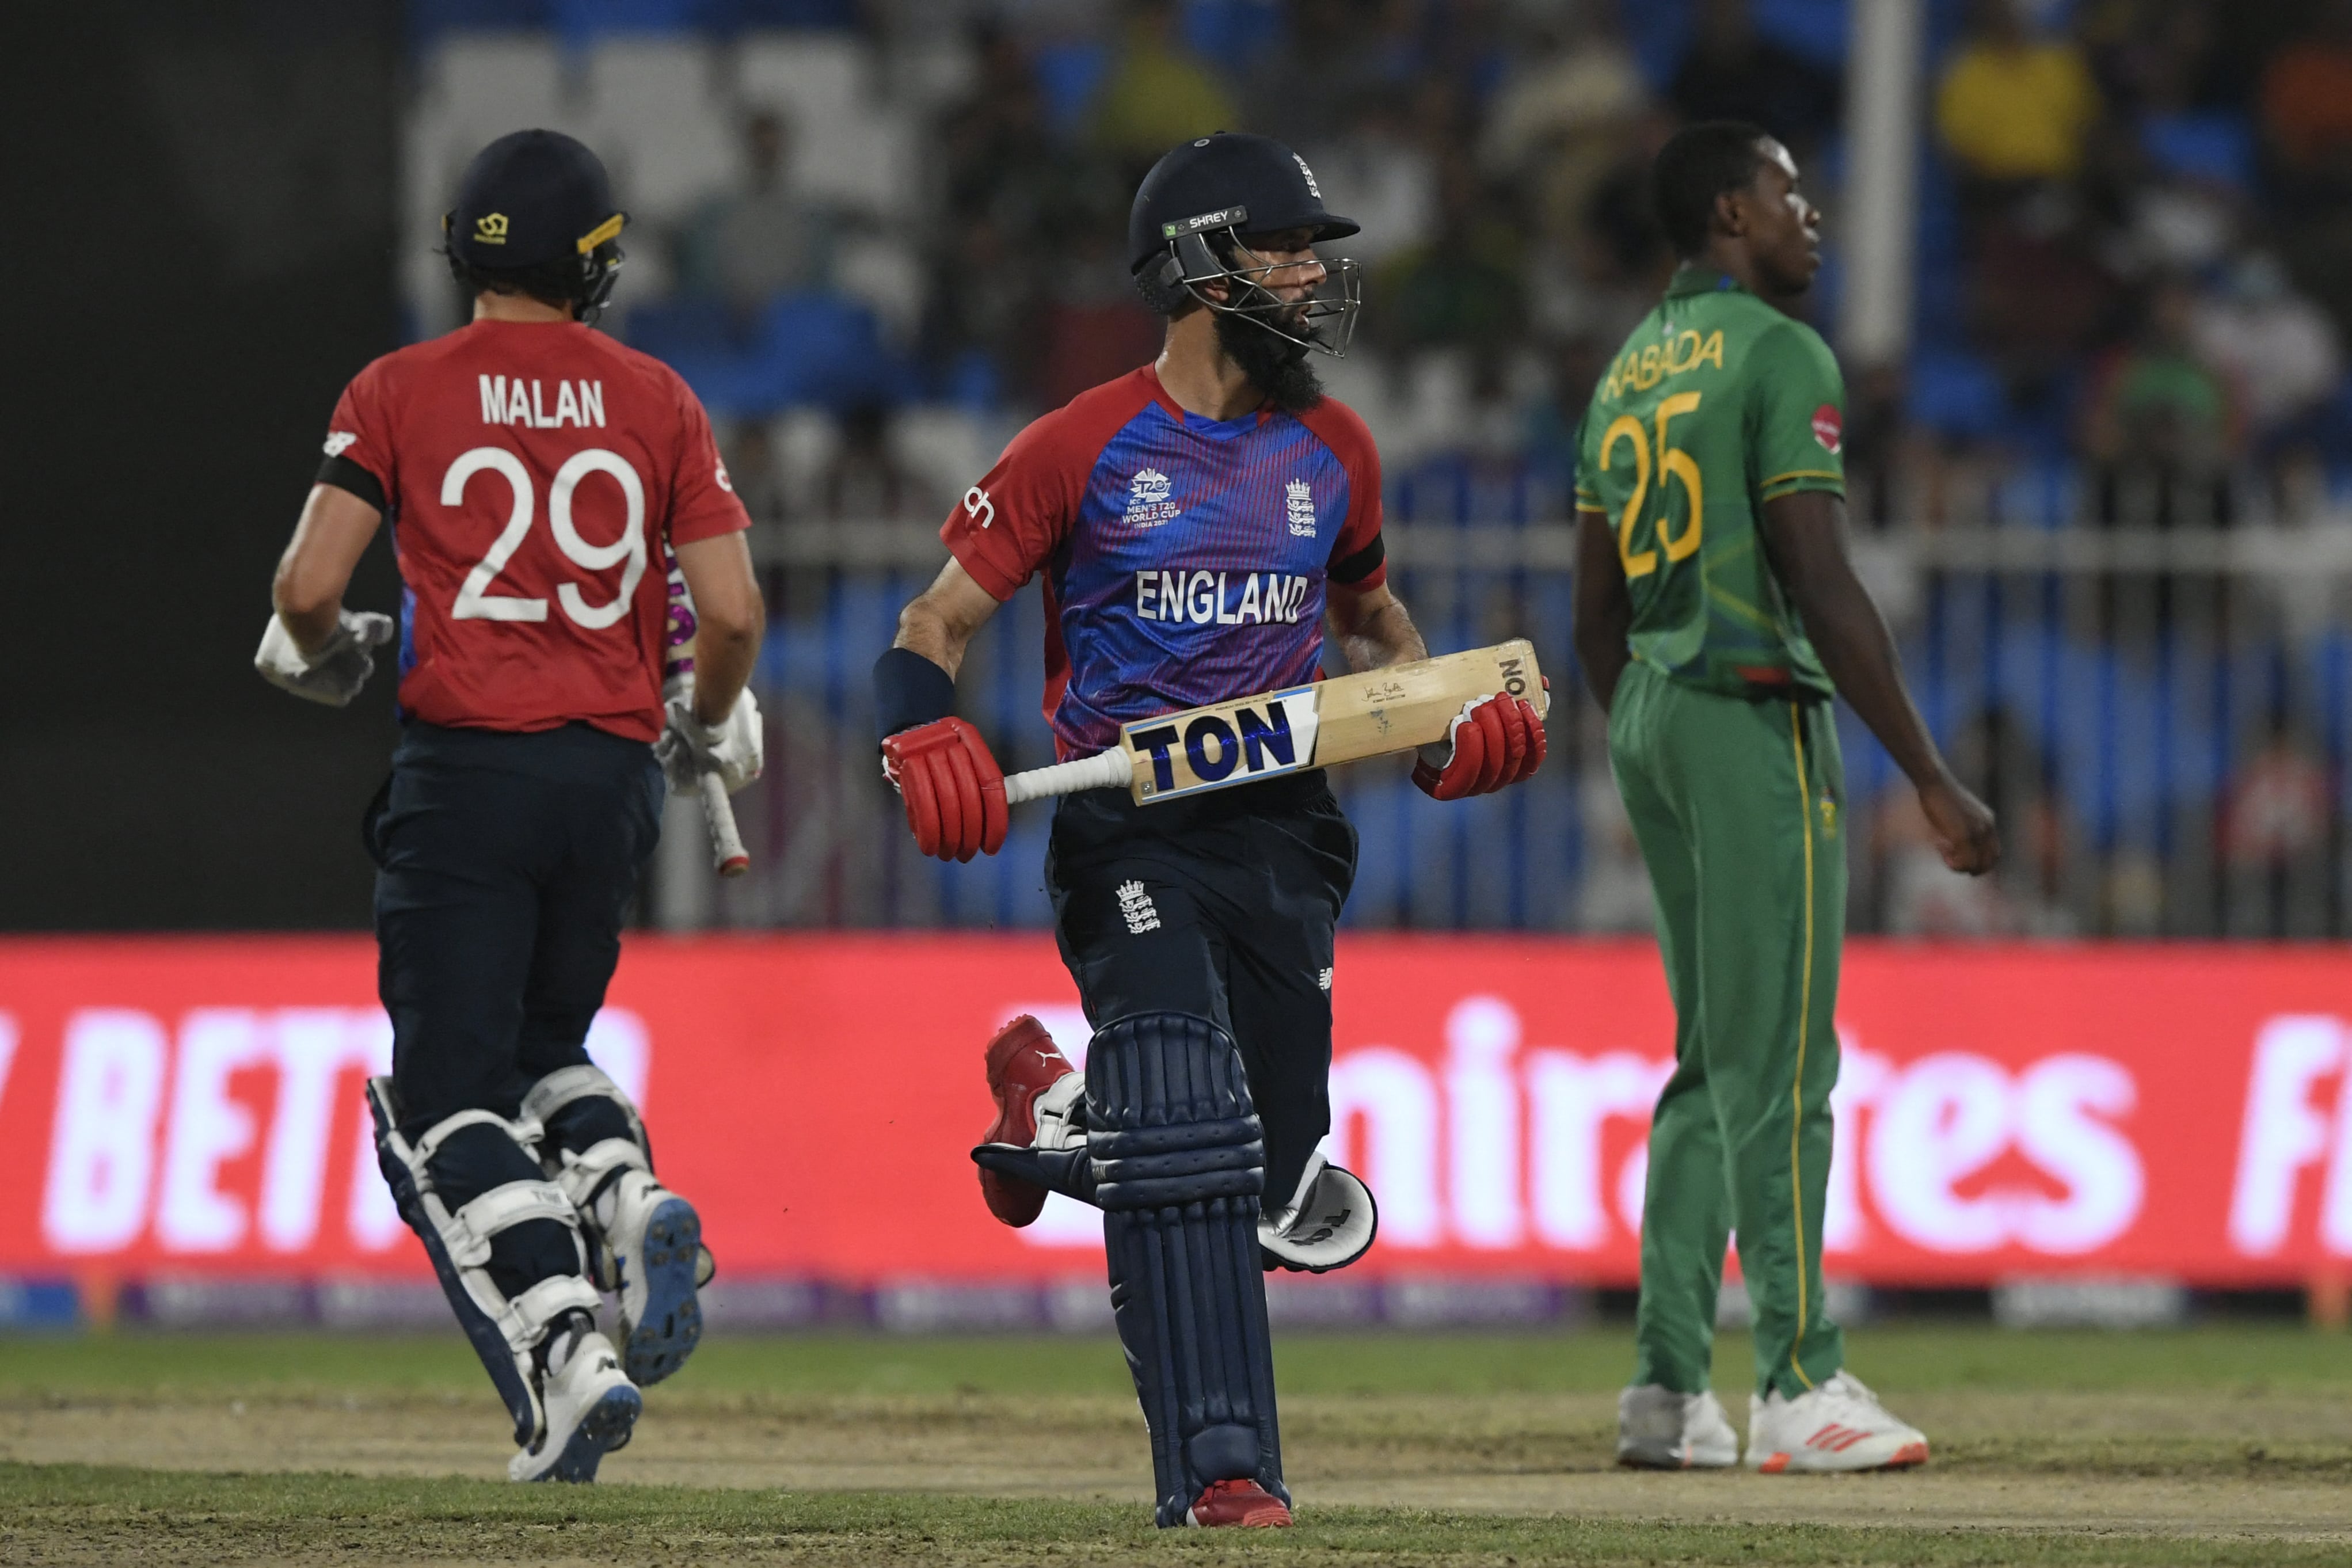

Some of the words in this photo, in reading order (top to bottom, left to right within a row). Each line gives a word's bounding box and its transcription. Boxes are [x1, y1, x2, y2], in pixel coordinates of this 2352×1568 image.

[1189, 210, 1228, 229] SHREY
[478, 374, 607, 428] MALAN
[1126, 503, 1157, 514] MEN'S
[1158, 501, 1175, 511] T20
[1599, 391, 1703, 579] 25
[440, 446, 646, 630] 29
[1122, 512, 1159, 524] WORLD
[1160, 509, 1181, 518] CUP
[1136, 569, 1308, 625] ENGLAND
[1499, 659, 1529, 701] ON
[1130, 700, 1296, 792] TON
